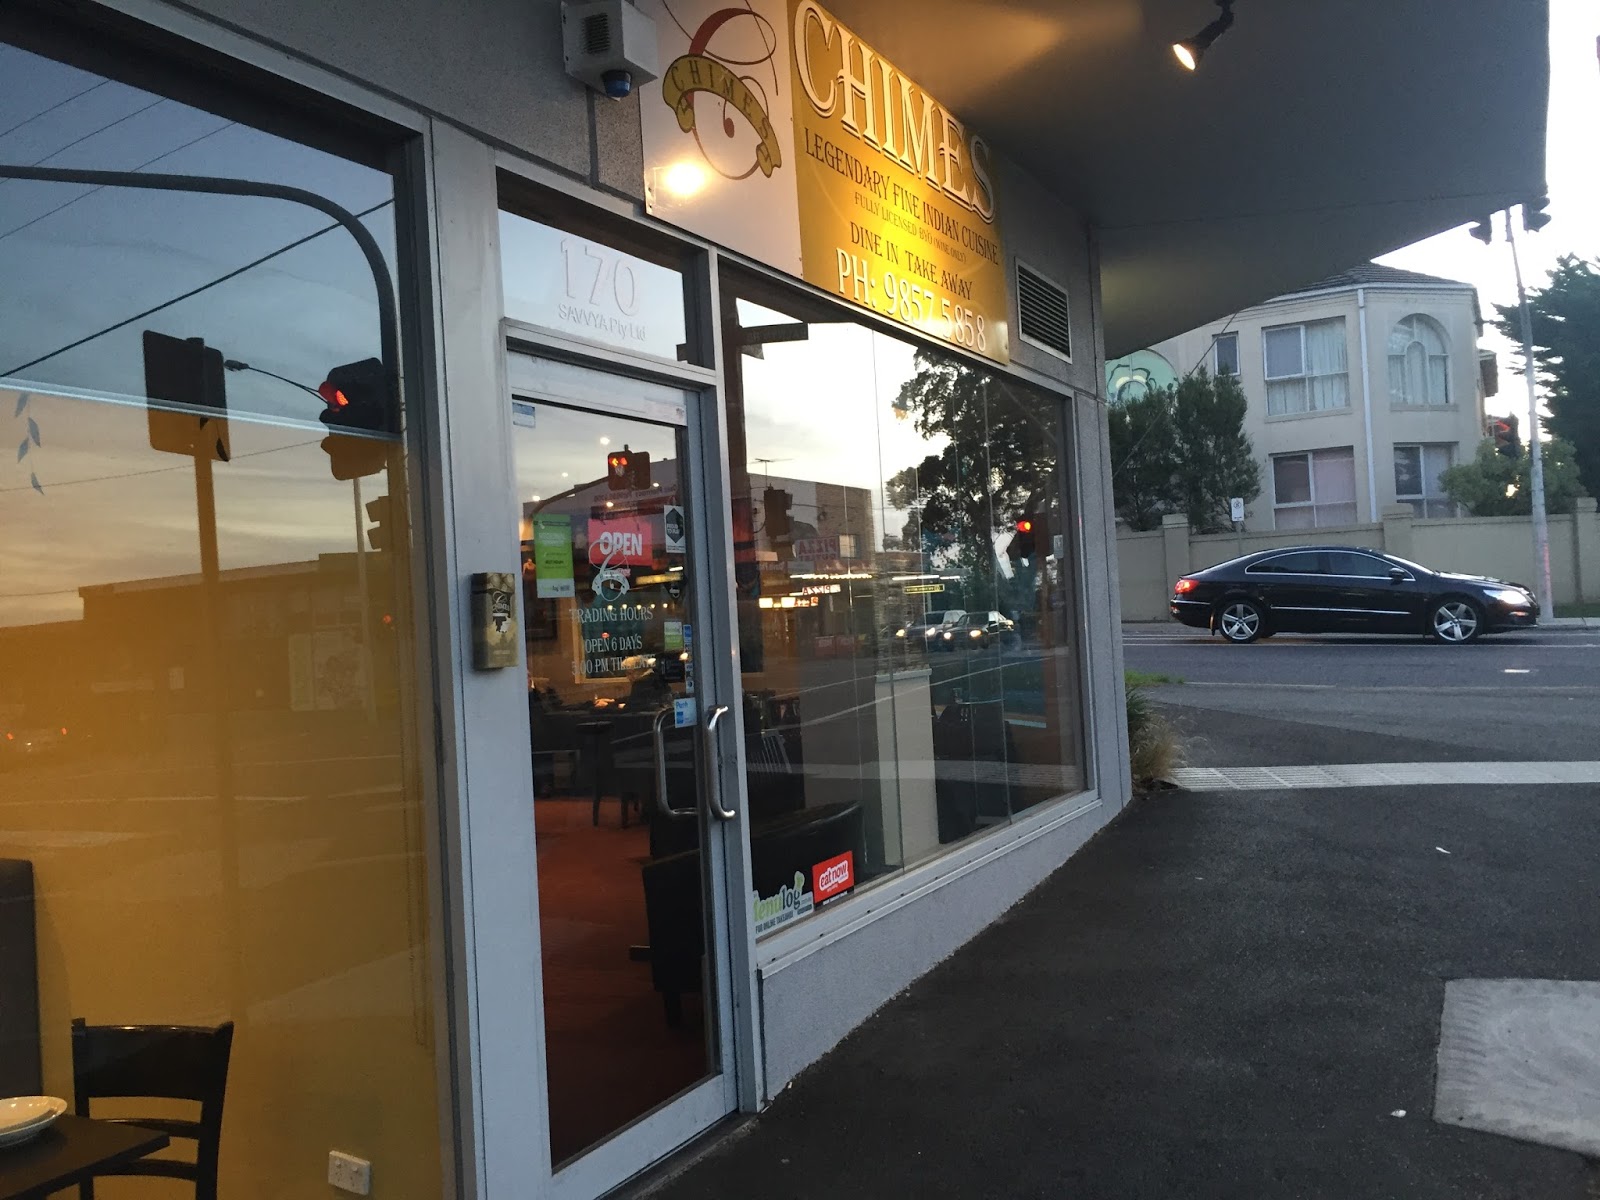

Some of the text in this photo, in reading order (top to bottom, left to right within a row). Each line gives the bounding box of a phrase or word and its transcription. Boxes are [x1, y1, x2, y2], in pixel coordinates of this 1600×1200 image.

[671, 60, 769, 139] CHIMES
[794, 0, 995, 223] CHIMES
[804, 127, 999, 266] LEGENDARY FINE INDIAN CUISINE
[855, 191, 880, 217] FULLY
[882, 206, 917, 236] LICENSED
[561, 239, 638, 317] 170
[850, 221, 973, 300] DINE IN TAKE AWAY
[836, 247, 986, 352] PH: 9857 5858
[600, 531, 643, 556] OPEN
[569, 606, 654, 623] TRADING HOURS
[585, 637, 609, 653] OPEN
[611, 637, 618, 651] 6
[595, 658, 609, 673] PM
[820, 870, 831, 888] eat
[832, 863, 847, 882] now
